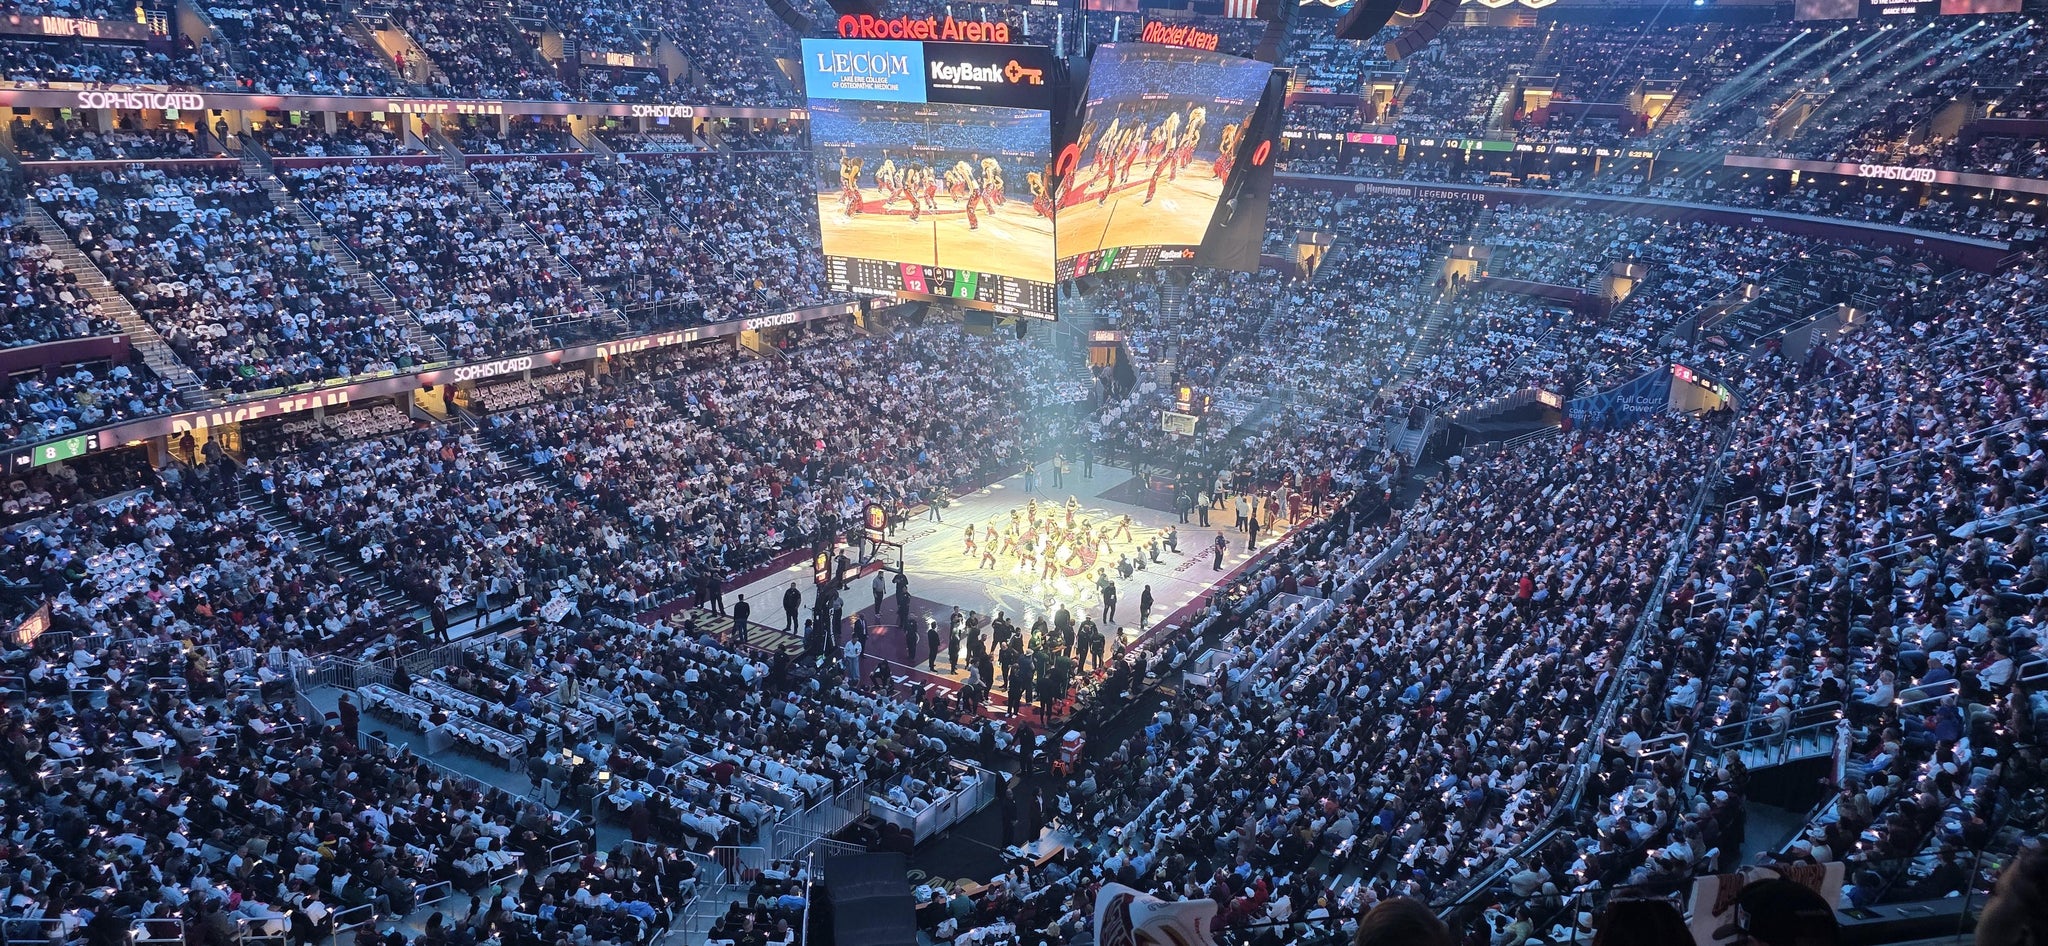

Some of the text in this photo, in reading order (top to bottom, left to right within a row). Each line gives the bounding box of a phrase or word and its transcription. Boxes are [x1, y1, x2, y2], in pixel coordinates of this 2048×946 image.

[79, 20, 99, 37] TEAM
[859, 14, 1009, 42] Rocket Arena
[1151, 20, 1219, 51] Rocket Arena
[931, 61, 1004, 84] KeyBank
[78, 92, 204, 110] SOPHISTICATED
[632, 105, 694, 118] SOPHISTICATED
[1373, 136, 1383, 144] 12
[1476, 141, 1483, 149] 8
[1555, 146, 1588, 155] FOULS 3
[1628, 150, 1642, 158] 6:22
[1858, 164, 1937, 182] SOPHISTICATED
[1366, 184, 1485, 201] Huntington LEGENDS CLUB
[909, 281, 921, 291] 12
[960, 287, 968, 298] 8
[747, 313, 796, 330] SOPHISTICATED
[454, 357, 532, 382] SOPHISTICATED
[1617, 395, 1663, 404] Full Court
[1622, 404, 1654, 413] Power
[45, 440, 97, 459] 8 3
